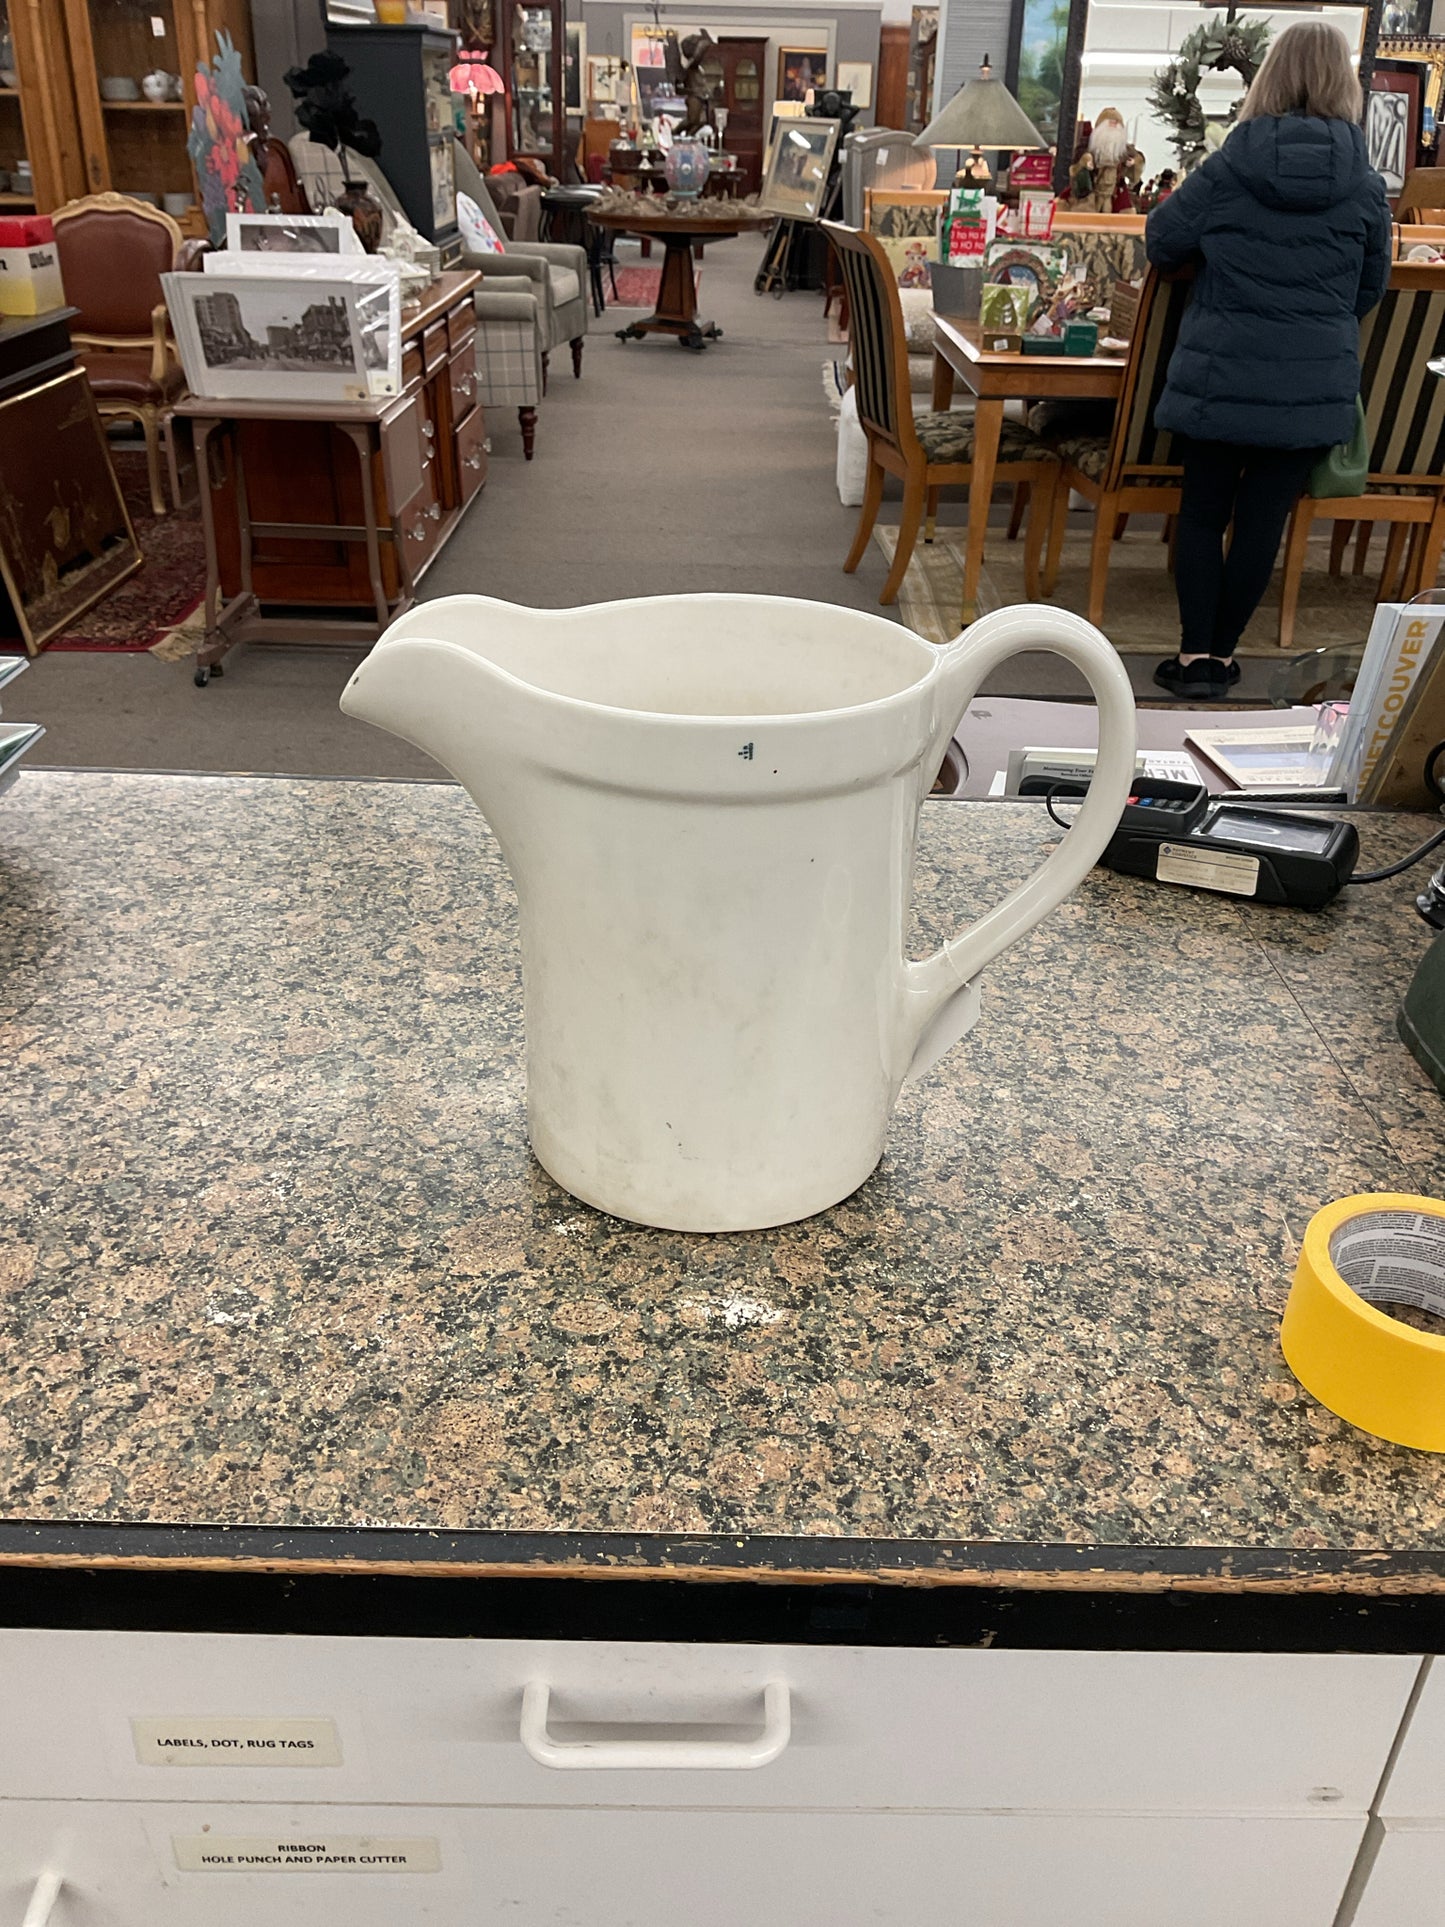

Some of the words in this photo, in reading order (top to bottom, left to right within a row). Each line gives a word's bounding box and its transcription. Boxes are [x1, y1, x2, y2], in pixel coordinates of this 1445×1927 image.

[157, 1739, 207, 1748] LABELS,
[211, 1740, 243, 1749] DOT,
[247, 1740, 276, 1748] RUG
